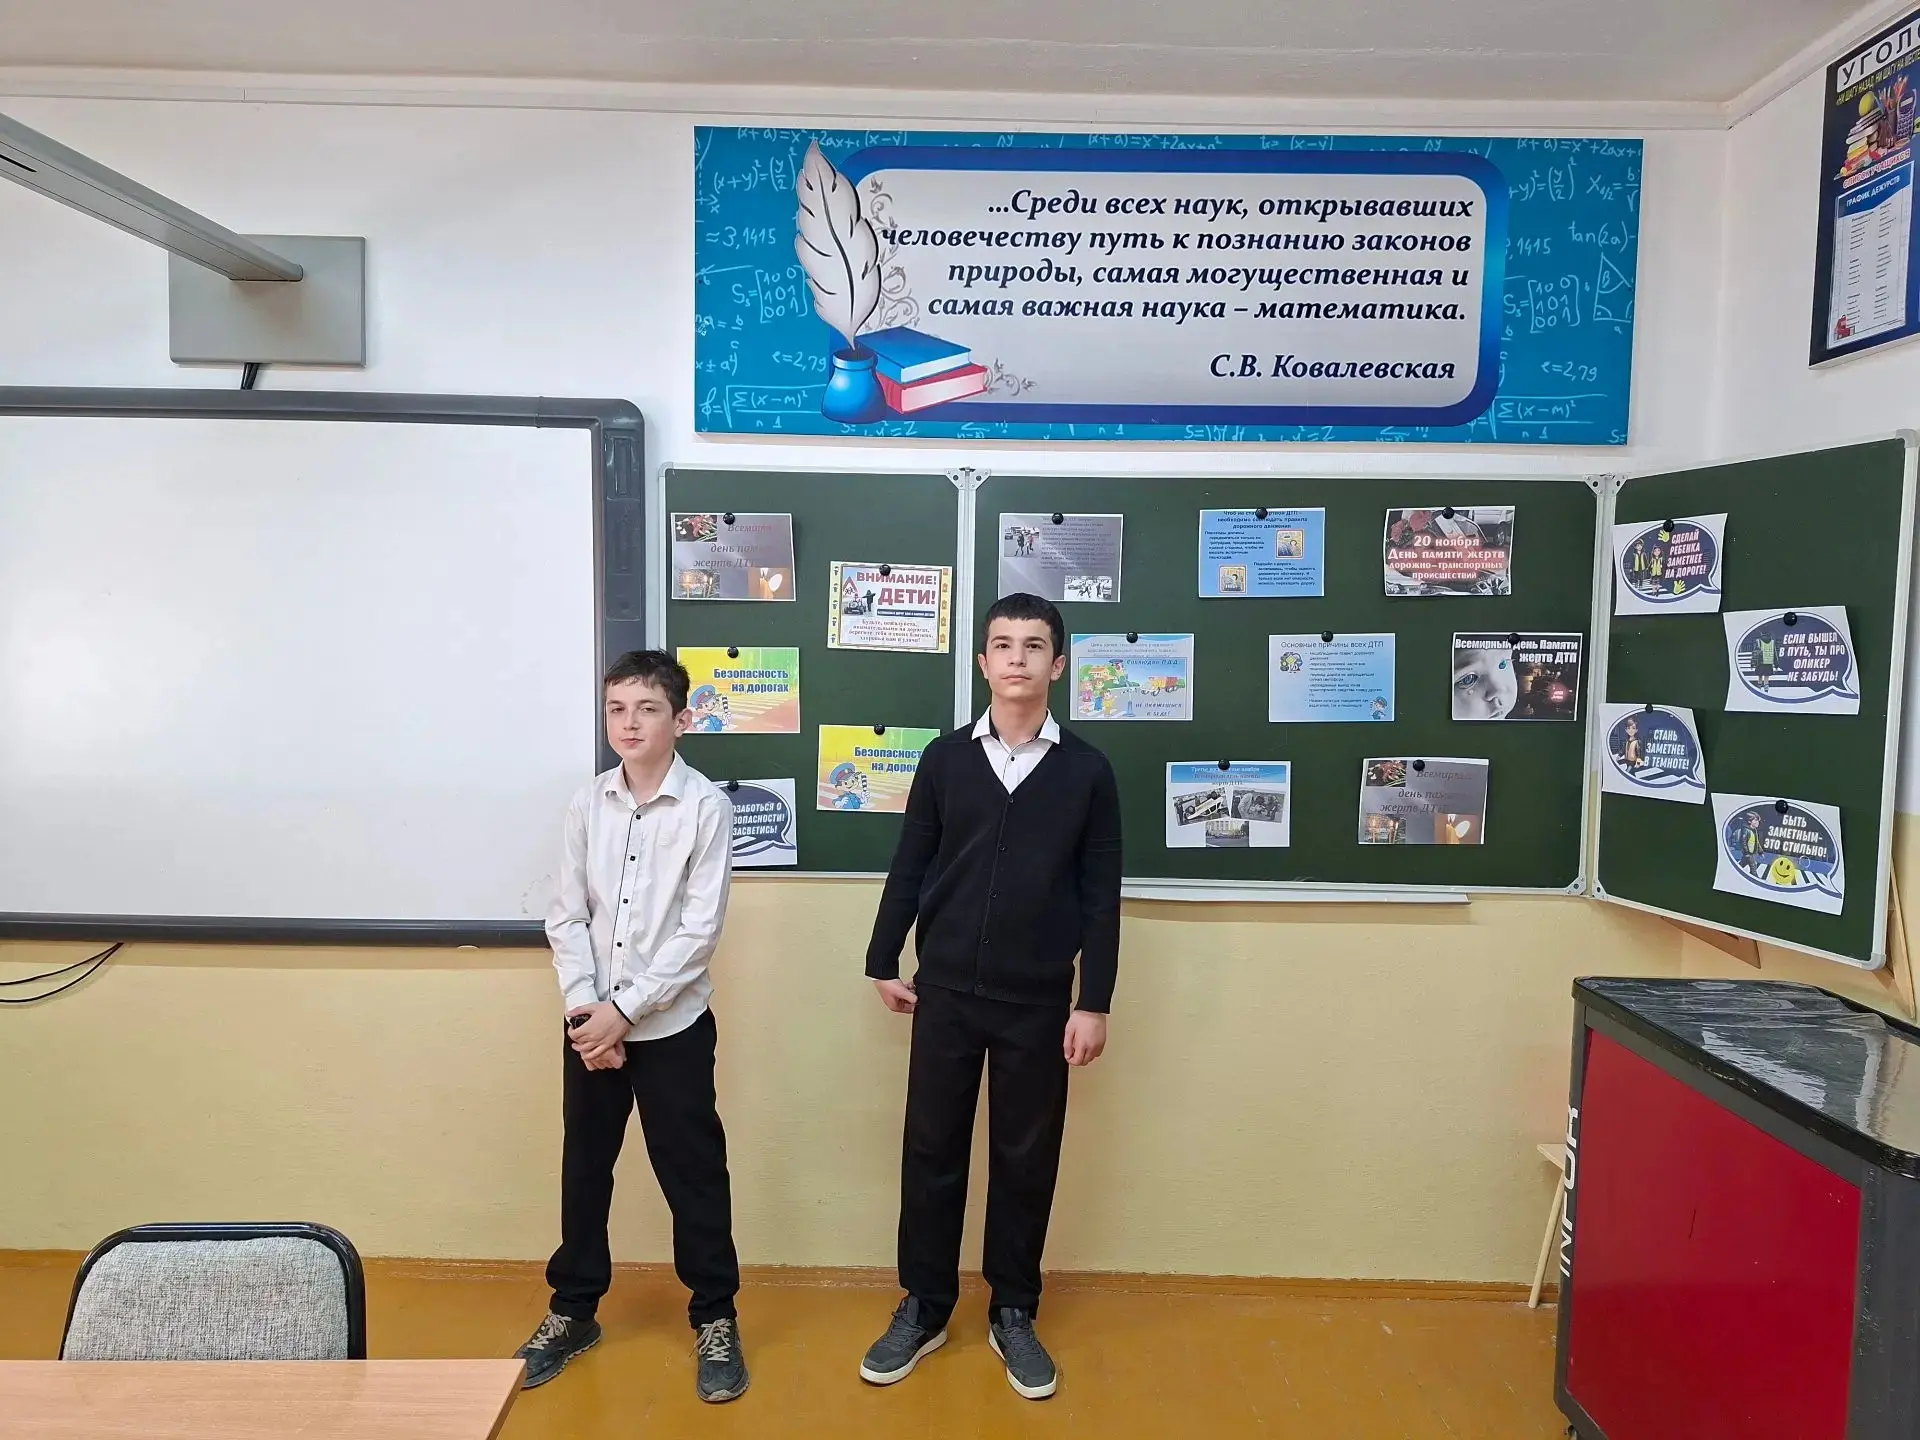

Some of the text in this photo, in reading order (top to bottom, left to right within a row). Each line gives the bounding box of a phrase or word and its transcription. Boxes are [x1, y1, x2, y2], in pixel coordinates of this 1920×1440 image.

[1842, 23, 1920, 86] УГОЛ
[989, 190, 1473, 222] ...Среди всех наук, открывавших
[882, 230, 1471, 255] человечеству путь к познанию законов
[949, 258, 1468, 291] природы, самая могущественная и
[929, 299, 1013, 315] самая
[1022, 301, 1133, 316] важная
[1142, 302, 1225, 324] наука
[1254, 303, 1464, 319] математика.
[1211, 355, 1454, 378] С.В. Ковалевская
[1414, 535, 1480, 548] 20 ноября
[1671, 529, 1699, 545] СДЕЛАЙ
[711, 543, 735, 553] день
[1669, 542, 1700, 556] РЕБЕНКА
[693, 560, 732, 569] жертв
[1667, 553, 1703, 567] ЗАМЕТНЕЕ
[857, 571, 937, 585] ВНИМАНИЕ!
[1665, 565, 1706, 579] НА ДОРОГЕ!
[878, 588, 937, 606] ДЕТИ!
[1368, 640, 1384, 649] ДТП
[1455, 639, 1511, 650] Всемирный
[1539, 640, 1578, 650] Памяти
[1783, 632, 1838, 645] ЕСЛИ ВЫШЕЛ
[1519, 652, 1577, 664] жертв ДТП
[1779, 645, 1845, 658] В ПУТЬ, ТЫ ПРО
[1793, 658, 1830, 669] ФЛИКЕР
[714, 668, 789, 678] Безопасность
[1787, 671, 1839, 682] НЕ ЗАБУДЬ!
[731, 683, 789, 694] на дорогах
[1654, 729, 1678, 742] СТАНЬ
[854, 747, 922, 758] Безопасност
[1645, 742, 1685, 755] ЗАМЕТНЕЕ
[871, 762, 918, 773] на дорог
[1644, 756, 1690, 770] В ТЕМНОТЕ!
[1398, 788, 1422, 798] день
[732, 802, 782, 813] ОЗАБОТЬСЯ О
[1380, 804, 1418, 814] жертв
[733, 813, 785, 825] ЗОПАСНОСТИ!
[1782, 814, 1807, 828] БЫТЬ
[732, 825, 778, 836] ЗАСВЕТИСЬ!
[1768, 825, 1823, 843] ЗАМЕТНЫМ-
[1763, 838, 1827, 858] ЭТО СТИЛЬНО!
